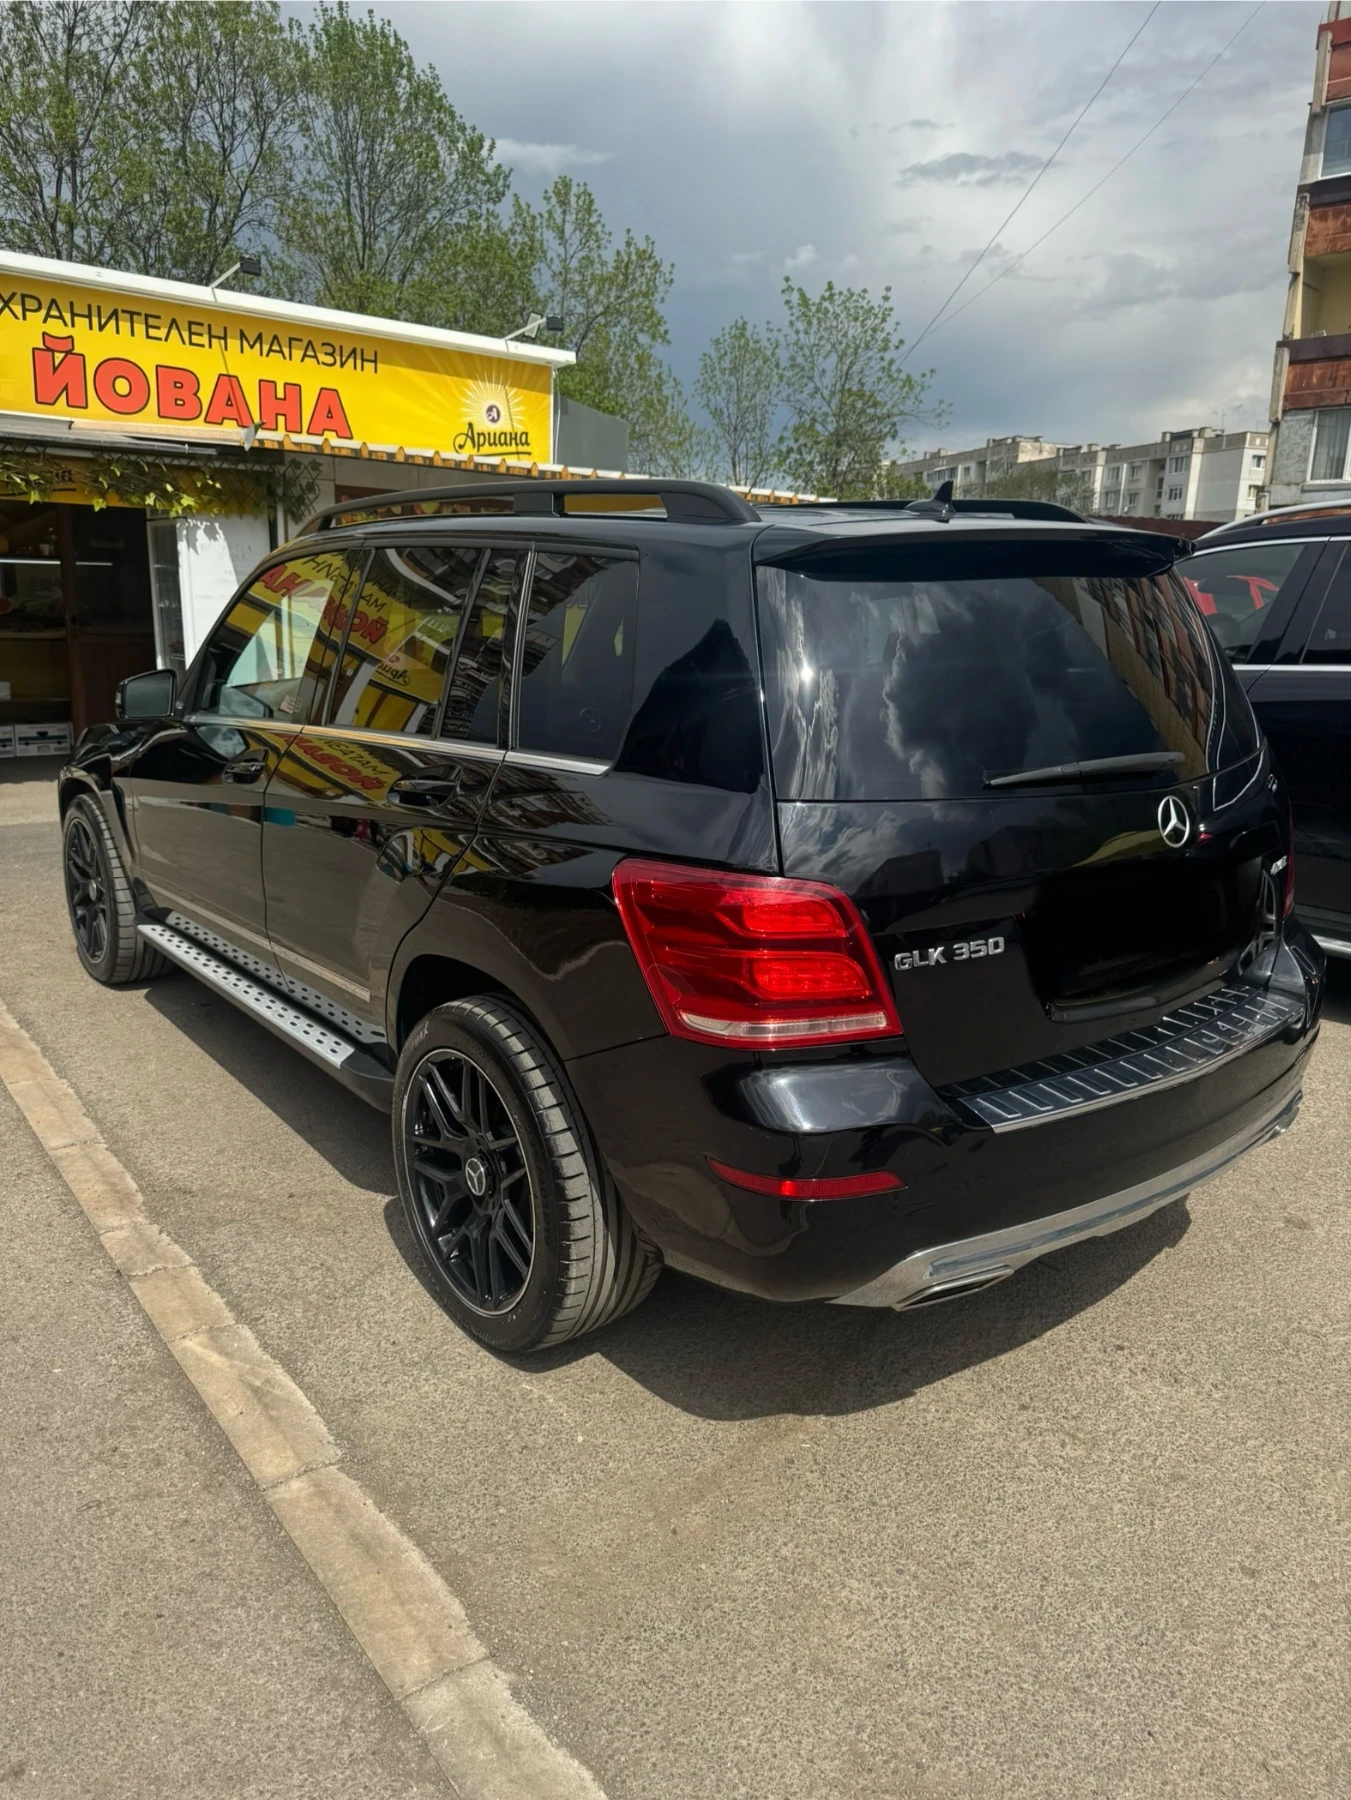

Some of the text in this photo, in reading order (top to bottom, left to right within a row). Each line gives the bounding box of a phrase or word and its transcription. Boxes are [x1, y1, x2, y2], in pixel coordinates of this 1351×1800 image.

[0, 291, 378, 374] ХРАНИТЕЛЕН МАГАЗИН
[32, 331, 353, 440] ЙОВАНА
[453, 422, 531, 455] Ариана
[894, 937, 1005, 971] GLK 350
